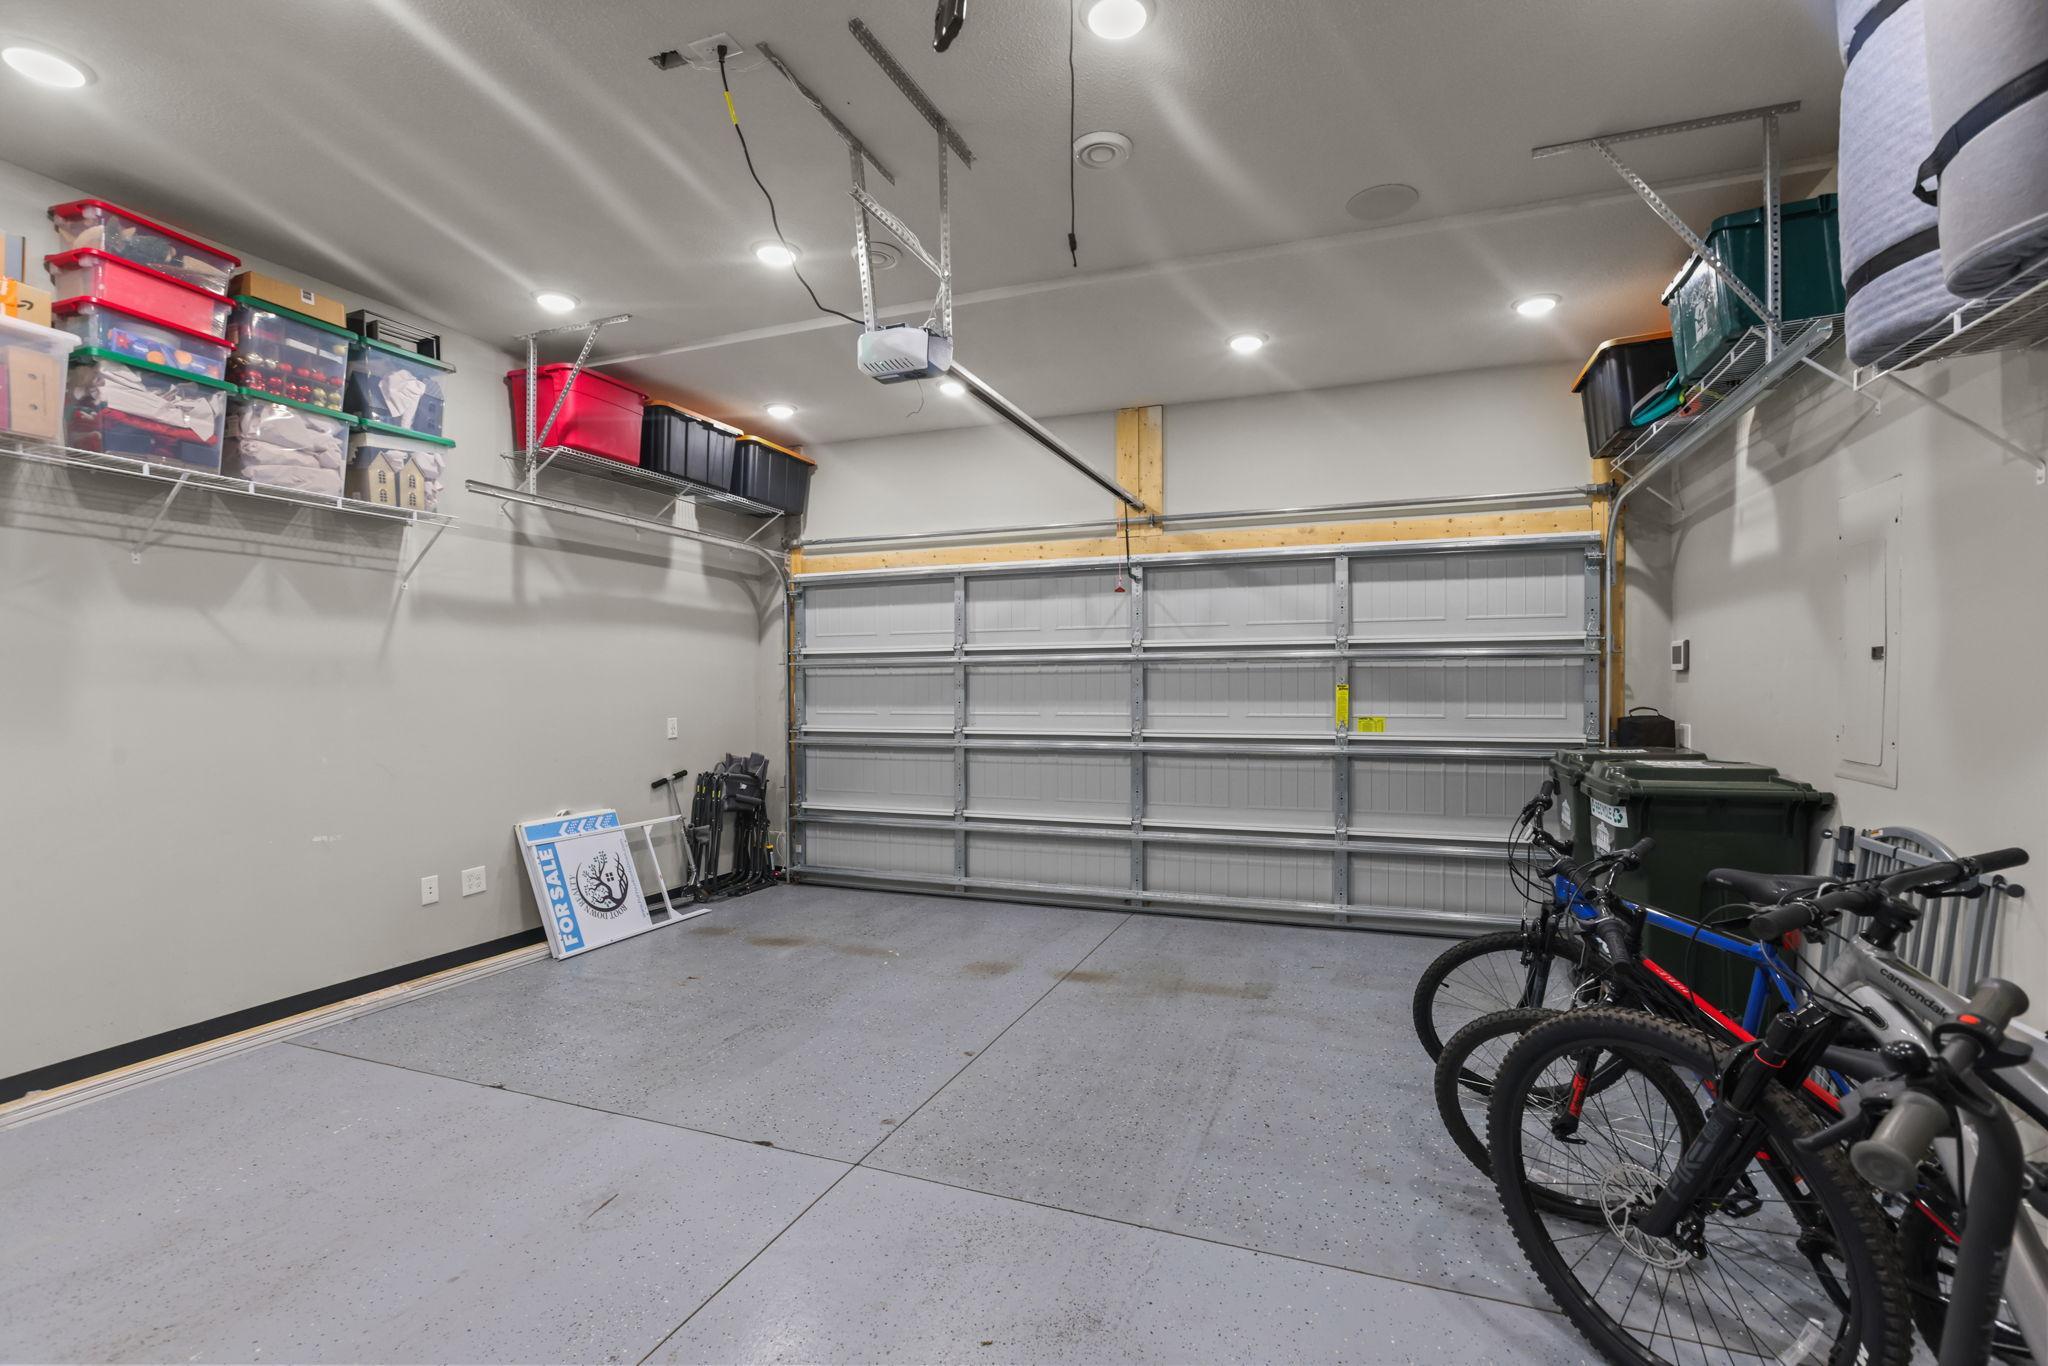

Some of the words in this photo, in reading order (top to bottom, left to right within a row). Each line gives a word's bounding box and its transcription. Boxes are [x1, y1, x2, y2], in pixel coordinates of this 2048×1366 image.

[538, 848, 565, 901] SALE
[569, 874, 585, 908] REALTY
[555, 902, 579, 946] FOR
[584, 904, 608, 920] DOWN
[609, 903, 628, 920] ROOT
